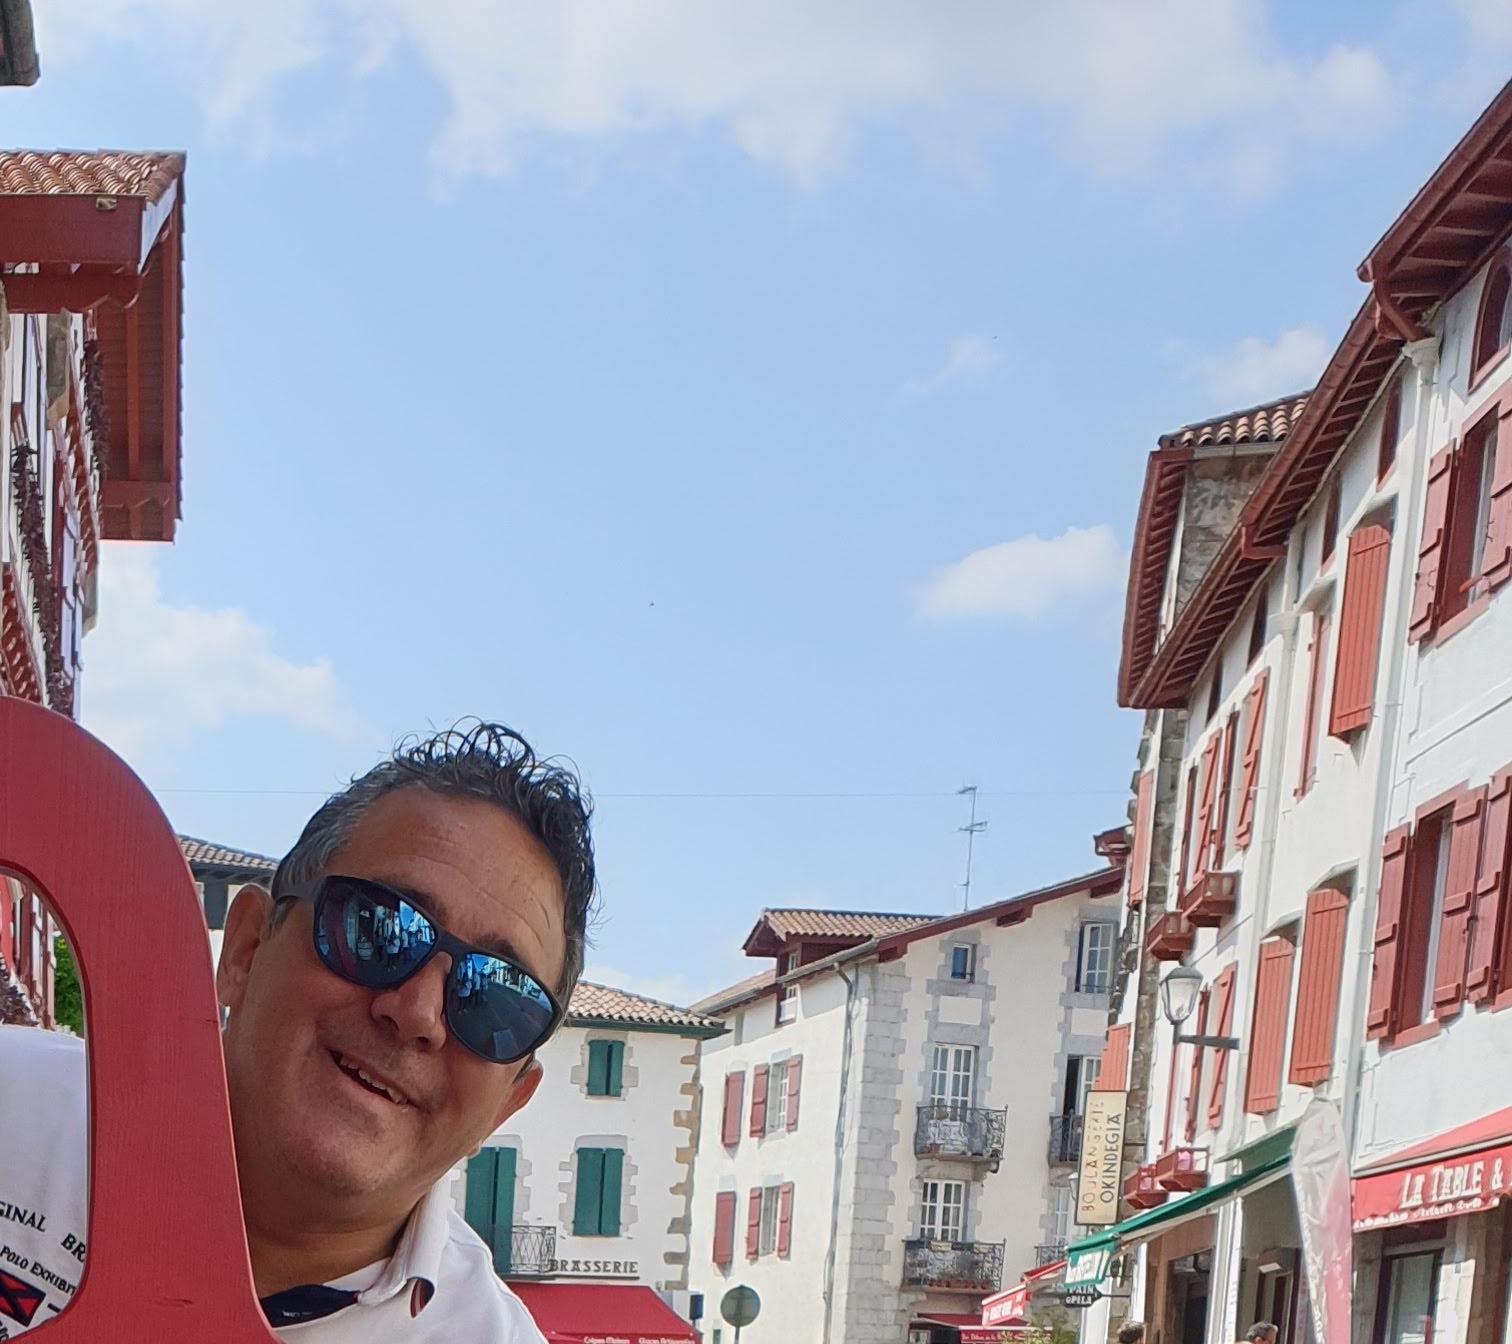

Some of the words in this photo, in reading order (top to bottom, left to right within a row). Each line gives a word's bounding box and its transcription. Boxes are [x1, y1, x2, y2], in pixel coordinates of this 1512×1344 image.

[1100, 1112, 1122, 1204] OKINDEGIA
[1399, 1172, 1425, 1209] LA
[1429, 1161, 1485, 1204] TABLE
[1491, 1157, 1504, 1190] &
[0, 1246, 29, 1270] POLO
[550, 1259, 638, 1274] BRASSERIE
